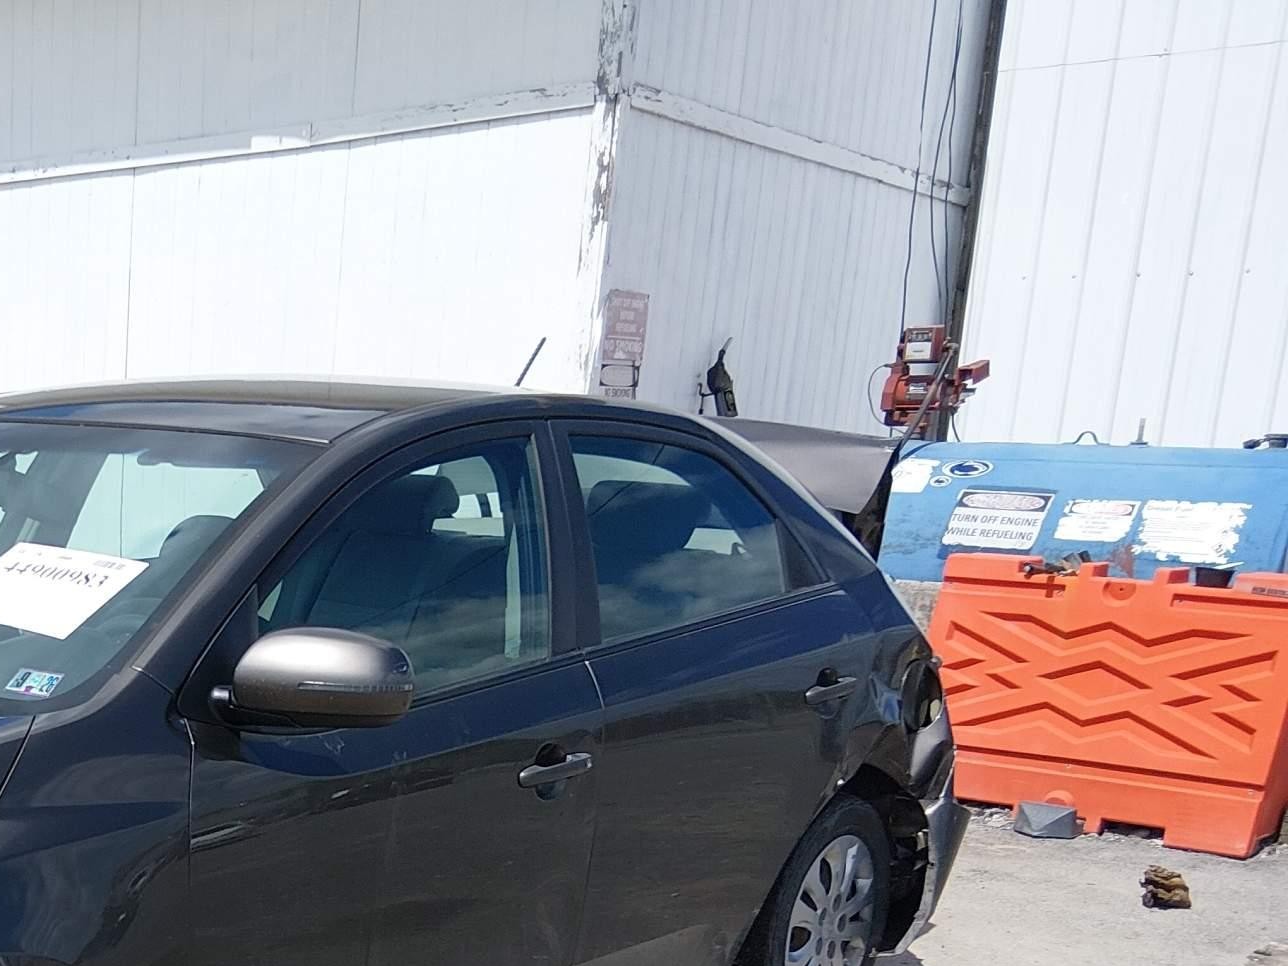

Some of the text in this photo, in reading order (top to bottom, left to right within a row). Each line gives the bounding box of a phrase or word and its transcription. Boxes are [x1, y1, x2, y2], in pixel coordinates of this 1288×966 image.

[951, 513, 1039, 527] TURN OFF ENGINE
[946, 526, 1033, 541] WHILE REFUELING
[4, 561, 109, 588] 44900983
